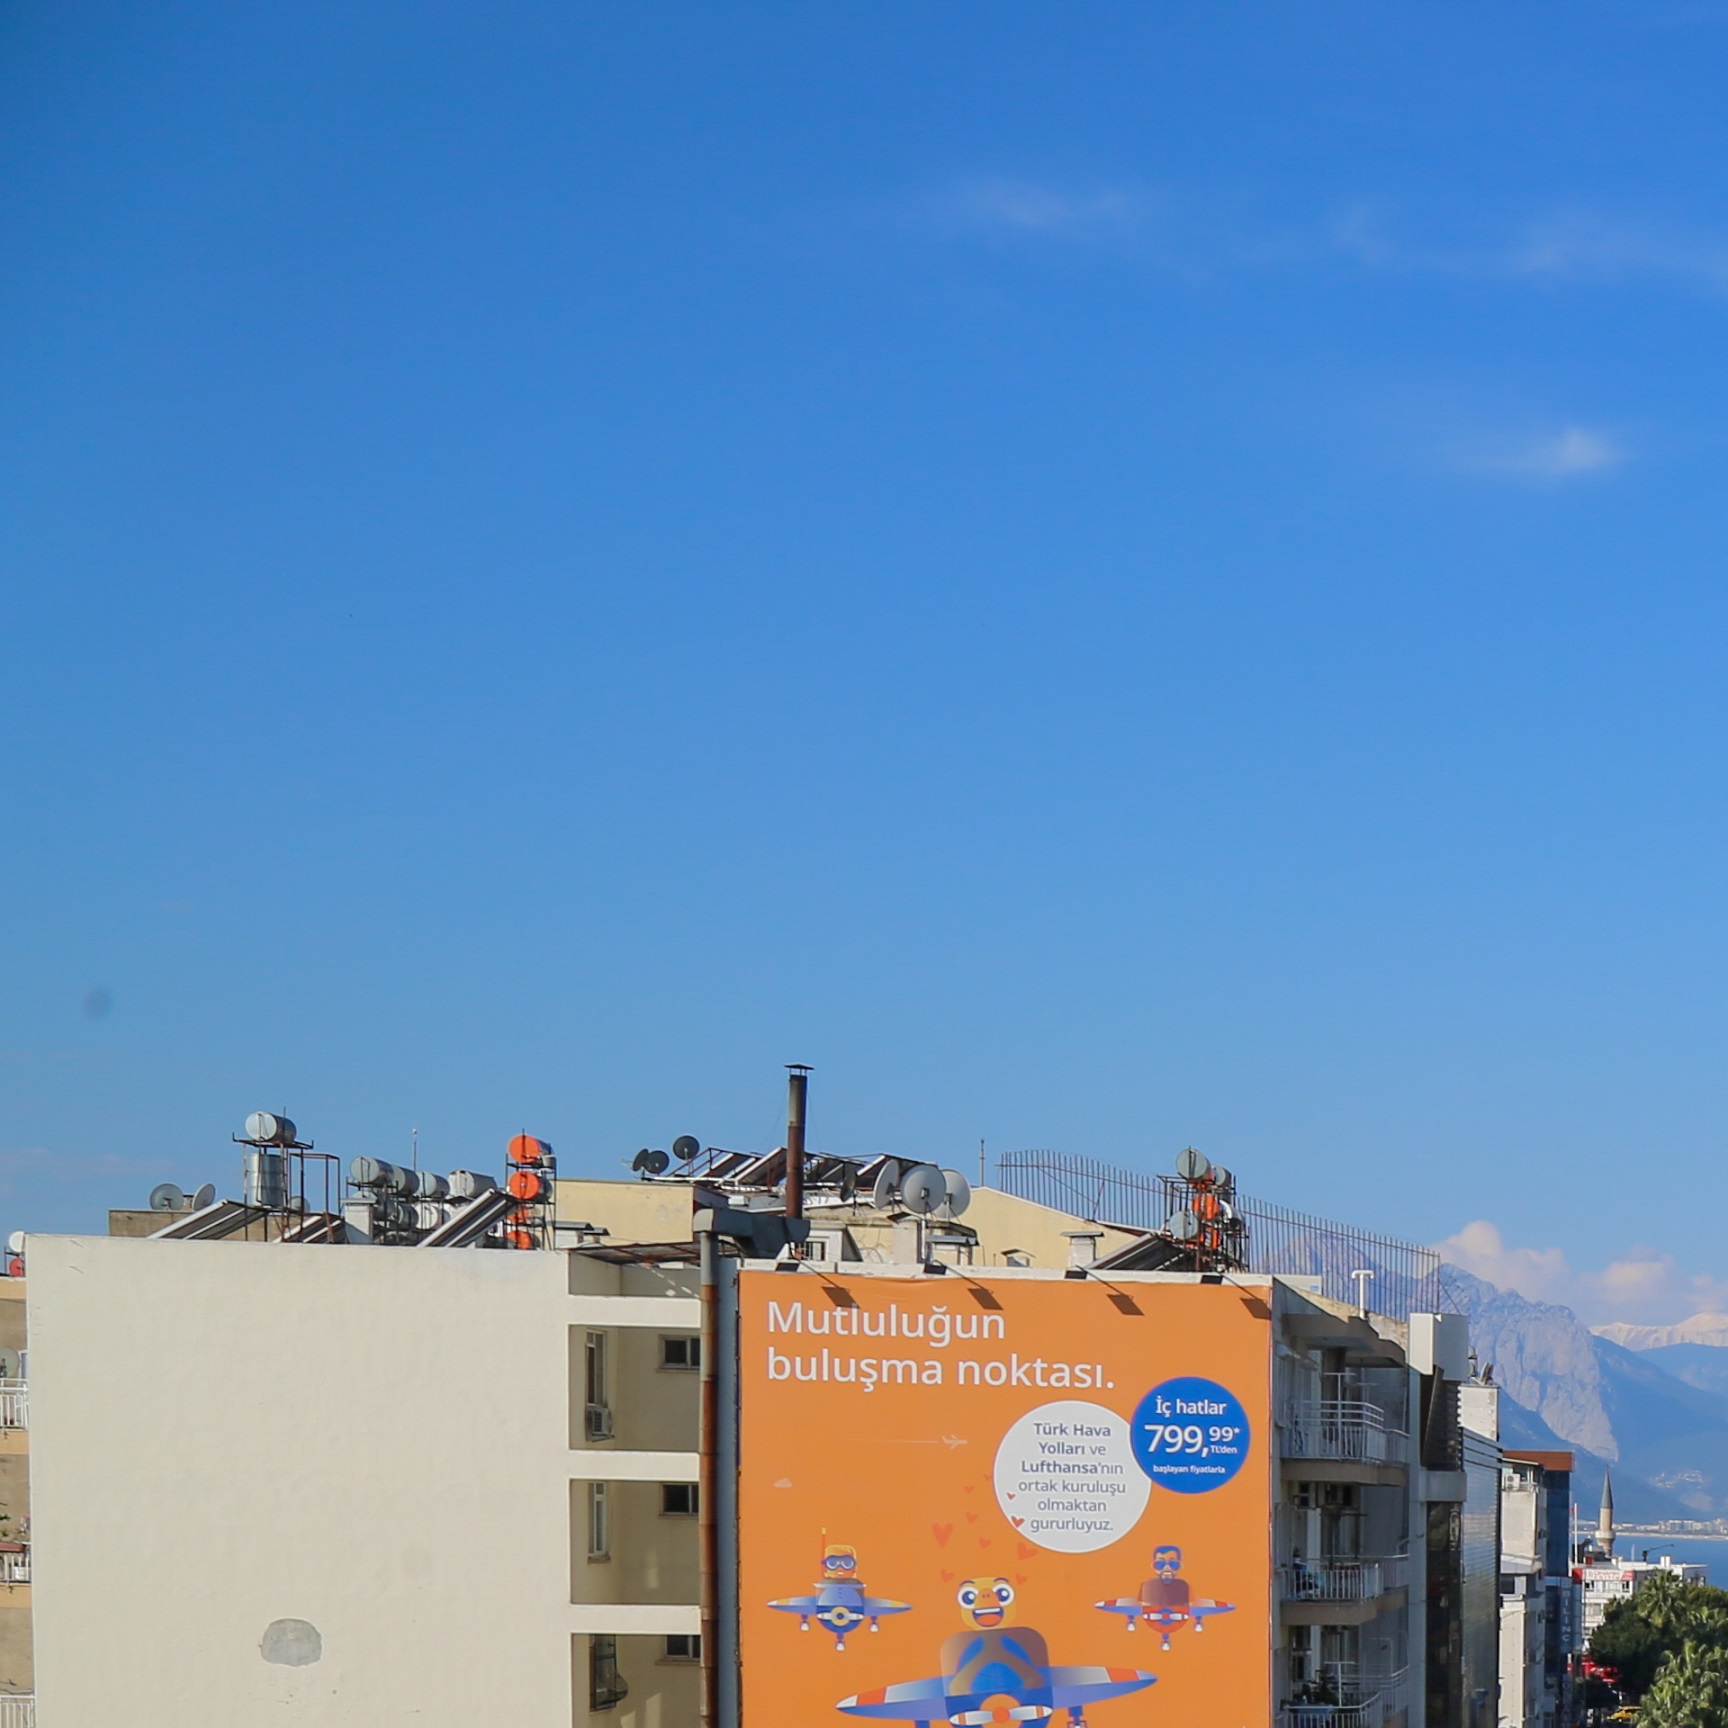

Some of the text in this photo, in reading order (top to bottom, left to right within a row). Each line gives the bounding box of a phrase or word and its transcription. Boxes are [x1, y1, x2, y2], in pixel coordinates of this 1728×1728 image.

[768, 1301, 1006, 1347] Mutluluğun
[768, 1346, 1115, 1392] buluşma noktası.
[1155, 1395, 1227, 1417] İç hatlar
[1034, 1422, 1111, 1437] Türk Hava
[1039, 1442, 1106, 1455] Yolları ve
[1021, 1460, 1123, 1474] Lufthansa'nın
[1153, 1464, 1225, 1475] başlayan fiyatlarla
[1018, 1479, 1126, 1497] ortak kuruluşu
[1038, 1499, 1107, 1512] olmaktan
[1030, 1517, 1114, 1534] gururluyuz.
